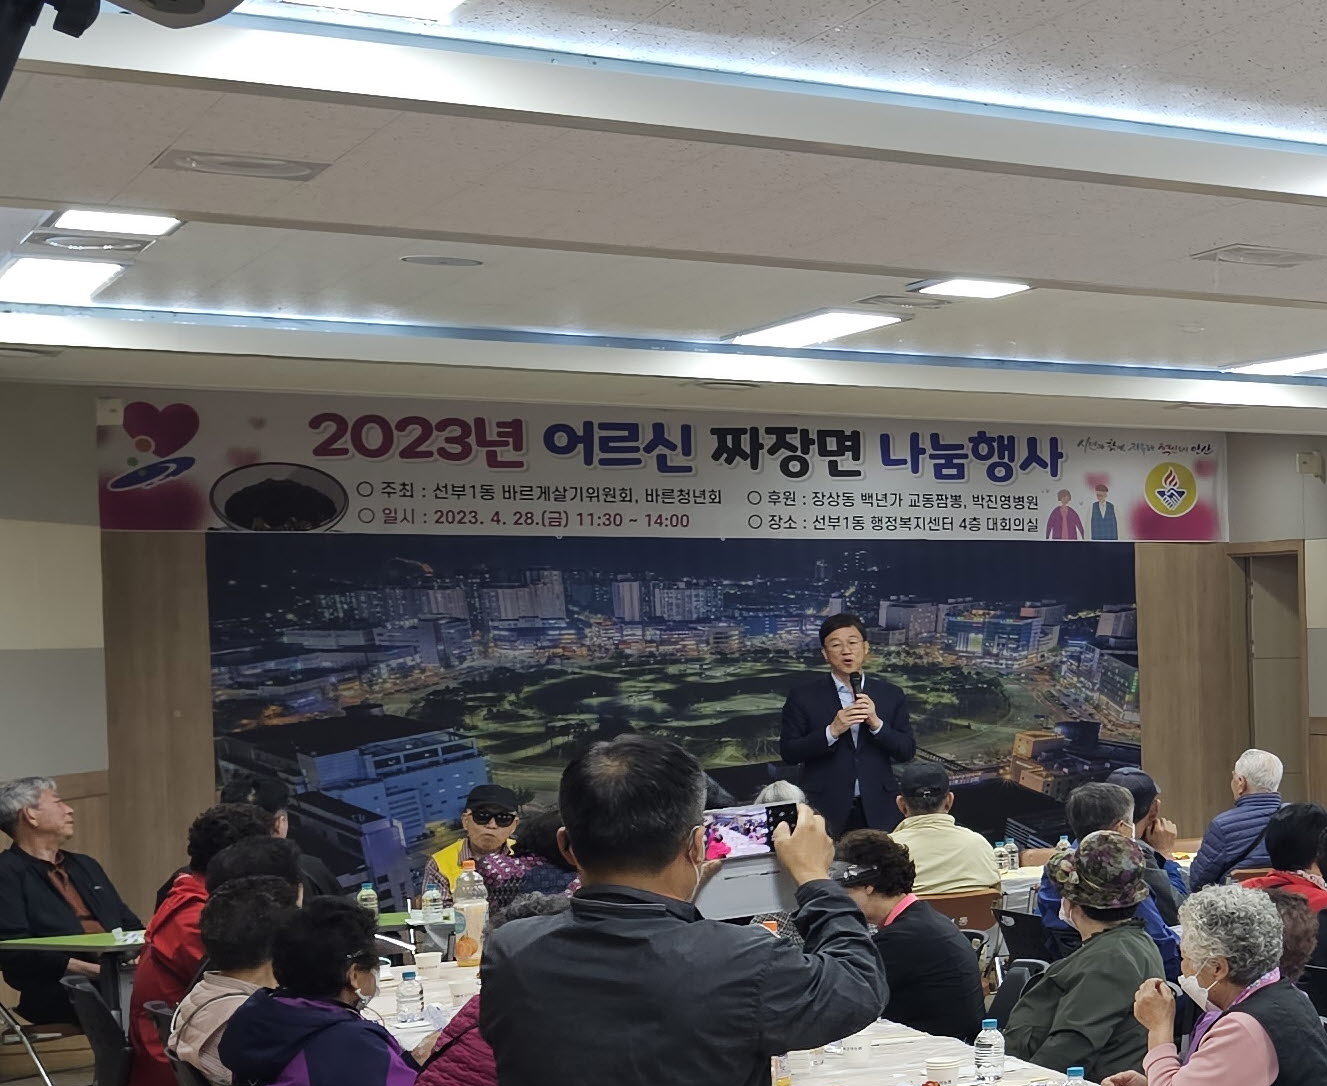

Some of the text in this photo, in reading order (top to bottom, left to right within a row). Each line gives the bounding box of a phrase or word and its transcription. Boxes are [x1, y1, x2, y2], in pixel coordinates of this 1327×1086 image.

[307, 412, 1065, 483] 2023년 어르신 짜장면 나눔행사
[380, 482, 415, 498] 주최
[433, 482, 496, 500] 선부1동
[502, 484, 639, 504] 바르게살기위원회,
[645, 488, 722, 506] 바른청년회
[767, 490, 797, 507] 후원
[811, 491, 856, 509] 장상동
[860, 491, 903, 509] 백년가
[972, 493, 1040, 511] 박진영병원
[382, 508, 416, 525] 일시
[434, 509, 484, 525] 2023.
[491, 510, 506, 526] 4.
[512, 509, 569, 527] 28.(금)
[576, 512, 623, 527] 11:30
[645, 514, 690, 529] 14:00
[768, 514, 797, 531] 장소
[812, 514, 866, 532] 선부1동
[870, 514, 955, 533] 행정복지센터
[958, 515, 983, 532] 4층
[986, 515, 1040, 533] 대회의실
